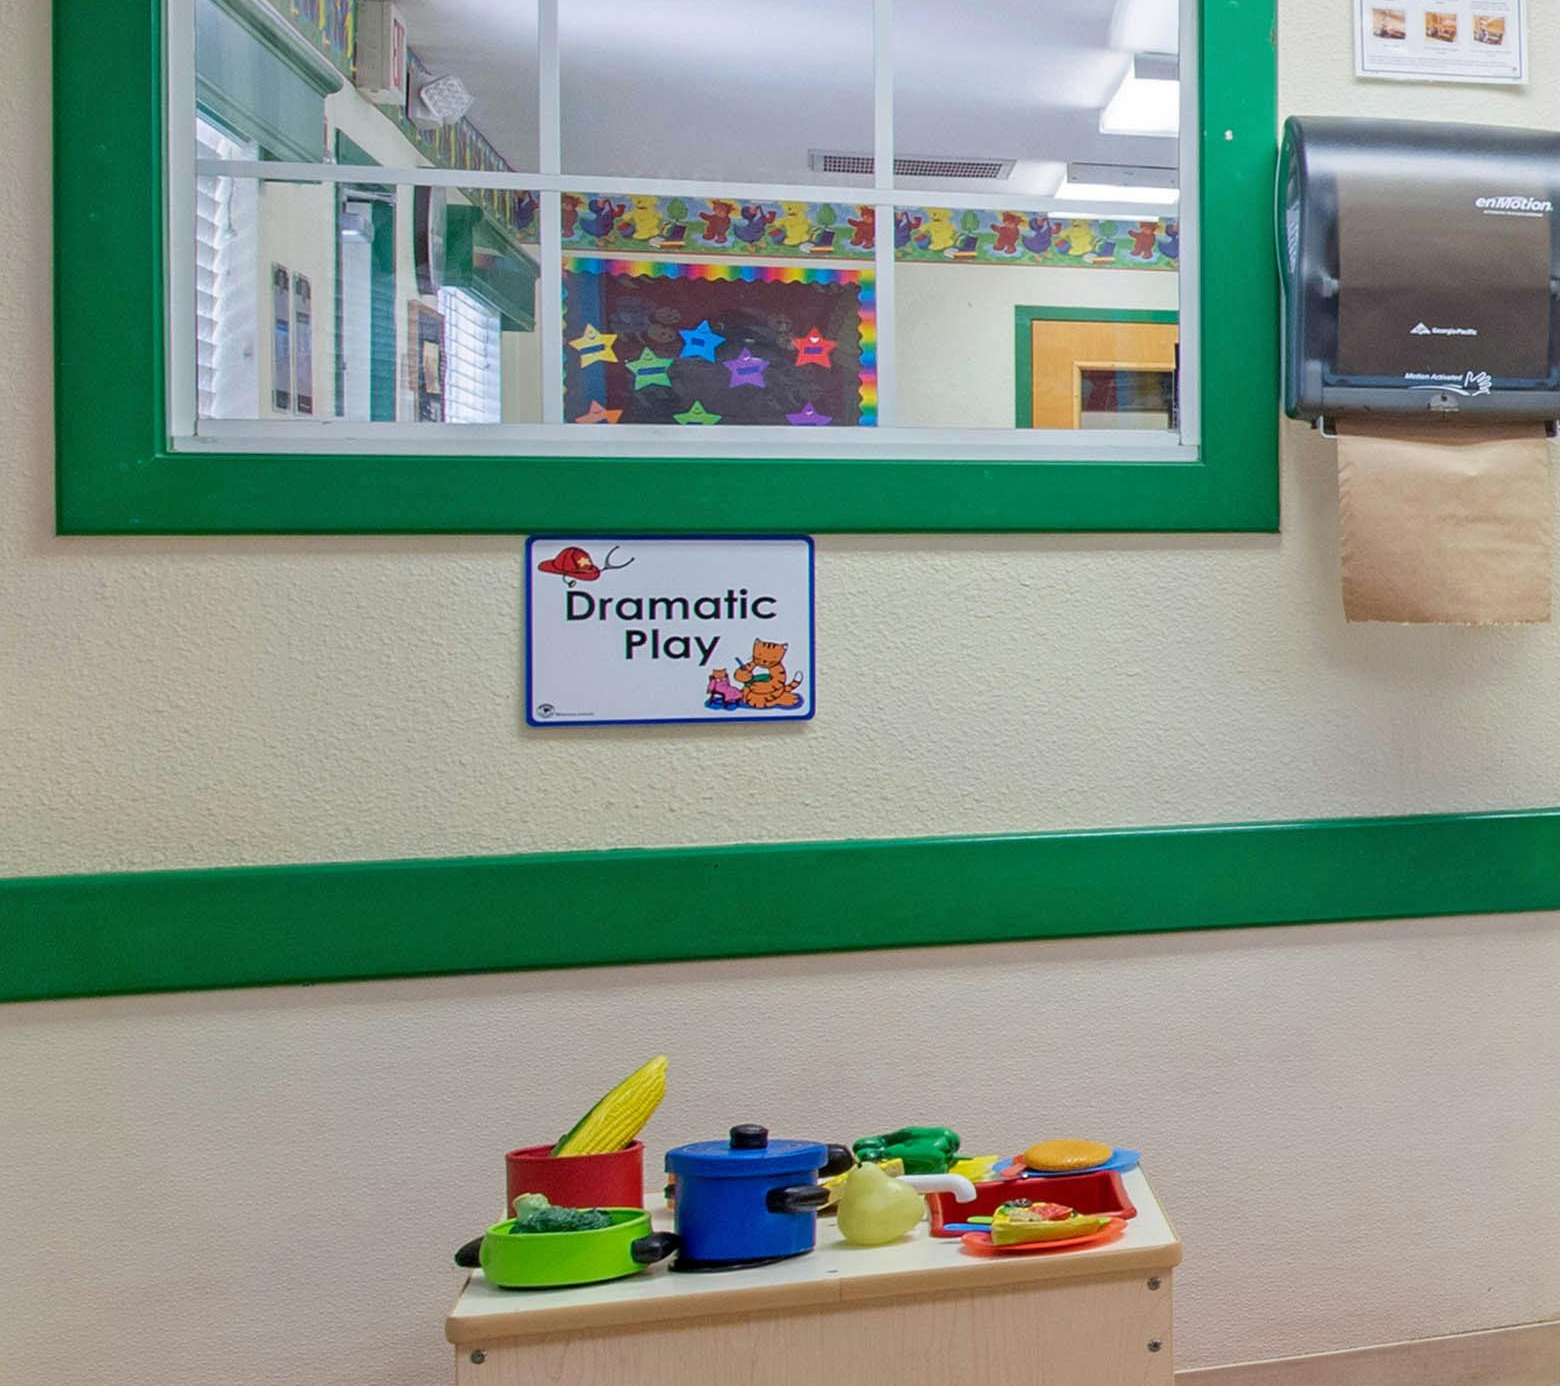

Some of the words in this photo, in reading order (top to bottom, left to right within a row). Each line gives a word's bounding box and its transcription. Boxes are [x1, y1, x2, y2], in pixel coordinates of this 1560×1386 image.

[1475, 196, 1552, 212] enMotion
[566, 589, 778, 622] Dramatic
[625, 629, 721, 666] Play
